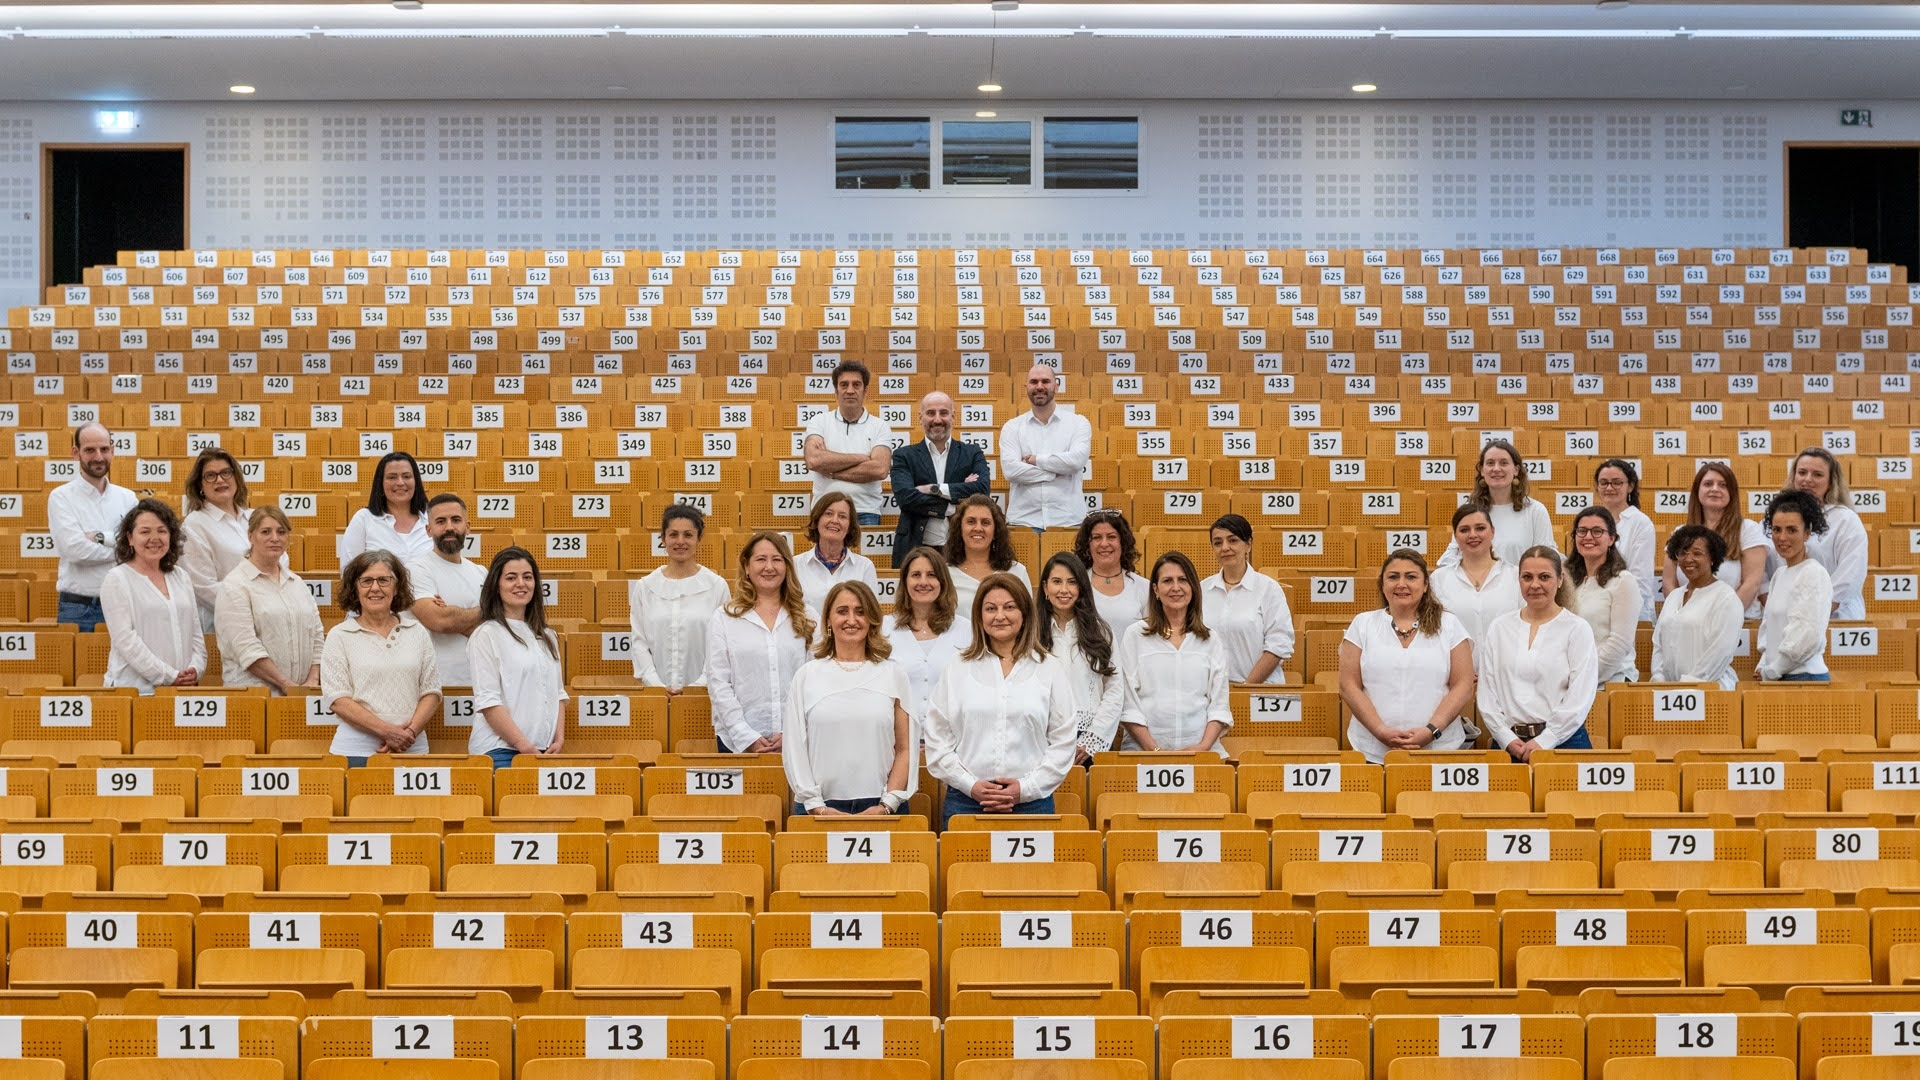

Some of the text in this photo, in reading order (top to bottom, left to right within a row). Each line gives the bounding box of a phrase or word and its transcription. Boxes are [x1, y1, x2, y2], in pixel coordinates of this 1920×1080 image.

[139, 255, 156, 264] 643
[255, 255, 272, 263] 645
[488, 255, 506, 263] 649
[722, 256, 739, 265] 653
[958, 254, 975, 263] 657
[1073, 254, 1091, 263] 659
[1191, 255, 1208, 263] 661
[1308, 255, 1325, 263] 663
[1483, 254, 1500, 263] 666
[1599, 253, 1617, 262] 668
[1714, 253, 1732, 262] 670
[1829, 253, 1846, 263] 672
[105, 272, 123, 282] 605
[347, 271, 365, 281] 609
[529, 272, 546, 281] 612
[775, 272, 792, 281] 616
[958, 271, 976, 280] 619
[1262, 271, 1280, 281] 624
[1504, 271, 1522, 281] 628
[1627, 270, 1645, 280] 630
[1870, 270, 1888, 280] 634
[68, 291, 87, 301] 567
[197, 290, 215, 300] 569
[452, 291, 470, 300] 573
[770, 291, 788, 300] 578
[961, 290, 979, 300] 581
[1344, 290, 1362, 300] 587
[1595, 290, 1613, 300] 591
[1849, 290, 1868, 300] 595
[33, 312, 51, 322] 529
[98, 312, 117, 322] 530
[365, 312, 384, 322] 534
[629, 312, 648, 322] 538
[894, 311, 913, 321] 542
[1158, 311, 1177, 321] 546
[1491, 311, 1510, 321] 551
[1758, 311, 1777, 321] 555
[1890, 311, 1909, 322] 557
[54, 335, 74, 345] 492
[331, 335, 352, 345] 496
[682, 335, 702, 346] 501
[961, 335, 981, 345] 505
[1242, 335, 1262, 345] 509
[1521, 334, 1540, 345] 513
[1797, 334, 1817, 344] 517
[10, 358, 32, 369] 454
[305, 358, 327, 369] 458
[597, 359, 618, 370] 462
[891, 358, 913, 369] 466
[1110, 358, 1131, 369] 469
[1404, 358, 1425, 369] 473
[1695, 358, 1716, 368] 477
[37, 378, 59, 390] 417
[343, 379, 365, 390] 421
[654, 377, 677, 388] 425
[962, 378, 984, 389] 429
[1349, 378, 1371, 389] 434
[1654, 377, 1677, 389] 438
[1884, 376, 1905, 387] 441
[1373, 405, 1396, 417] 396
[1531, 404, 1554, 415] 398
[1694, 404, 1718, 415] 400
[1856, 402, 1879, 414] 402
[72, 410, 94, 422] 380
[154, 410, 176, 421] 381
[476, 411, 499, 422] 385
[883, 410, 906, 422] 390
[965, 410, 988, 422] 391
[1212, 410, 1235, 422] 394
[19, 438, 43, 451] 342
[448, 439, 472, 451] 347
[1141, 437, 1165, 449] 355
[1313, 438, 1337, 450] 357
[1570, 437, 1594, 450] 360
[1742, 437, 1766, 449] 362
[1827, 437, 1851, 449] 363
[50, 463, 75, 475] 305
[141, 463, 167, 476] 306
[327, 463, 353, 476] 308
[509, 463, 534, 476] 310
[690, 463, 715, 476] 312
[784, 461, 809, 476] 313
[1157, 462, 1183, 475] 317
[1334, 462, 1360, 476] 319
[1882, 460, 1907, 473] 325
[284, 496, 311, 510] 270
[482, 498, 510, 511] 272
[578, 497, 605, 511] 273
[778, 496, 805, 509] 275
[1169, 494, 1197, 508] 279
[1267, 495, 1295, 508] 280
[1367, 494, 1395, 508] 281
[1561, 494, 1588, 508] 283
[1660, 493, 1687, 507] 284
[1854, 493, 1881, 506] 286
[26, 536, 55, 550] 233
[552, 537, 581, 551] 238
[1288, 533, 1317, 548] 242
[1392, 533, 1421, 547] 243
[1317, 579, 1348, 595] 207
[1881, 577, 1911, 592] 212
[1838, 631, 1871, 647] 176
[48, 700, 84, 717] 128
[182, 700, 218, 717] 129
[586, 699, 622, 717] 132
[1661, 694, 1697, 712] 140
[250, 772, 290, 791] 100
[402, 771, 442, 791] 101
[547, 771, 586, 791] 102
[693, 771, 735, 791] 103
[1145, 768, 1185, 788] 106
[1292, 768, 1332, 787] 107
[1440, 767, 1480, 787] 108
[1586, 767, 1626, 786] 109
[1736, 766, 1776, 785] 110
[1882, 766, 1920, 785] 111
[111, 772, 137, 792] 99
[17, 839, 46, 860] 69
[179, 839, 209, 860] 70
[675, 838, 704, 859] 73
[843, 837, 873, 858] 74
[1006, 837, 1036, 858] 75
[1173, 837, 1203, 858] 76
[1335, 835, 1365, 856] 77
[1502, 833, 1532, 855] 78
[1667, 834, 1697, 855] 79
[1832, 833, 1861, 854] 80
[343, 839, 373, 861] 71
[510, 840, 540, 861] 72
[84, 918, 118, 942] 40
[267, 919, 300, 942] 41
[451, 918, 485, 942] 42
[639, 920, 673, 944] 43
[828, 918, 863, 942] 44
[1018, 917, 1052, 941] 45
[1198, 917, 1233, 941] 46
[1386, 917, 1420, 940] 47
[1573, 917, 1607, 941] 48
[1763, 915, 1797, 938] 49
[179, 1024, 216, 1050] 11
[394, 1023, 431, 1050] 12
[607, 1024, 644, 1051] 13
[823, 1024, 861, 1051] 14
[1035, 1025, 1072, 1052] 15
[1253, 1024, 1291, 1051] 16
[1461, 1023, 1497, 1050] 17
[1678, 1022, 1714, 1049] 18
